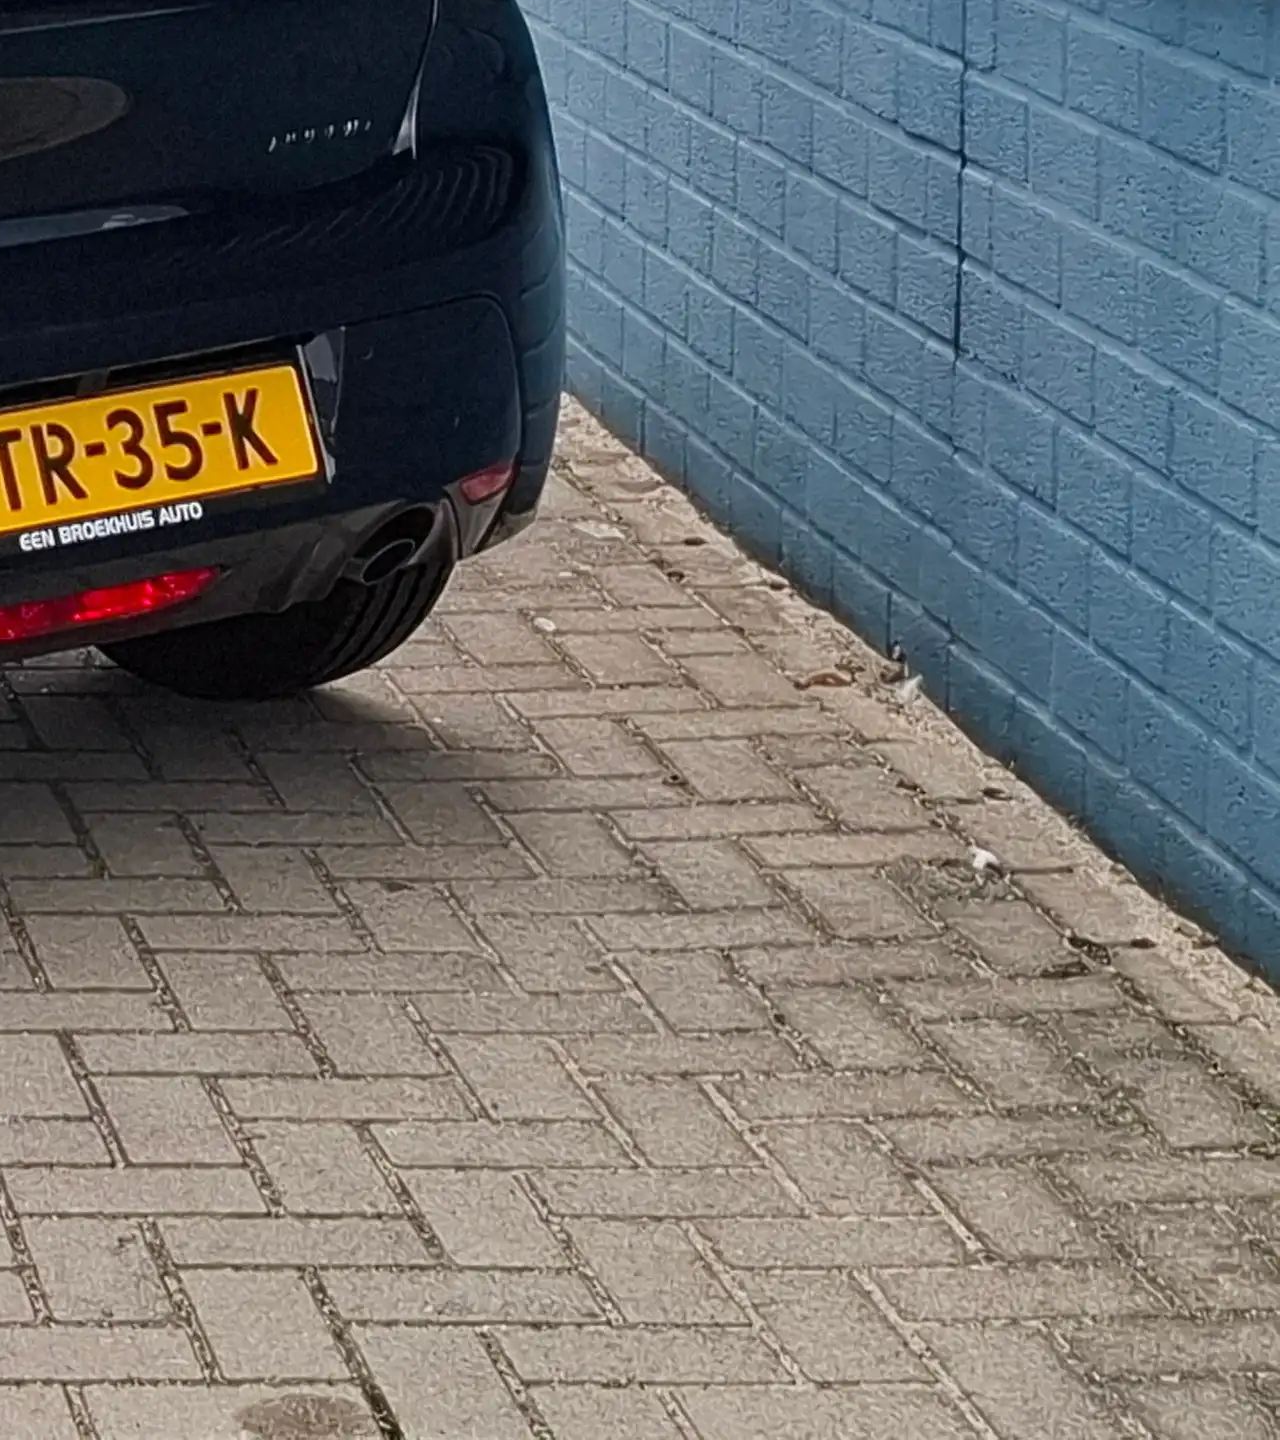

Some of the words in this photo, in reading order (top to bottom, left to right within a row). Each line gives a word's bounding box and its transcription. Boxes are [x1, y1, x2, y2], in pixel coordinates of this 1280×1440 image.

[19, 528, 57, 552] EEN
[58, 509, 155, 545] BROEKHUIS
[159, 501, 204, 527] AUTO
